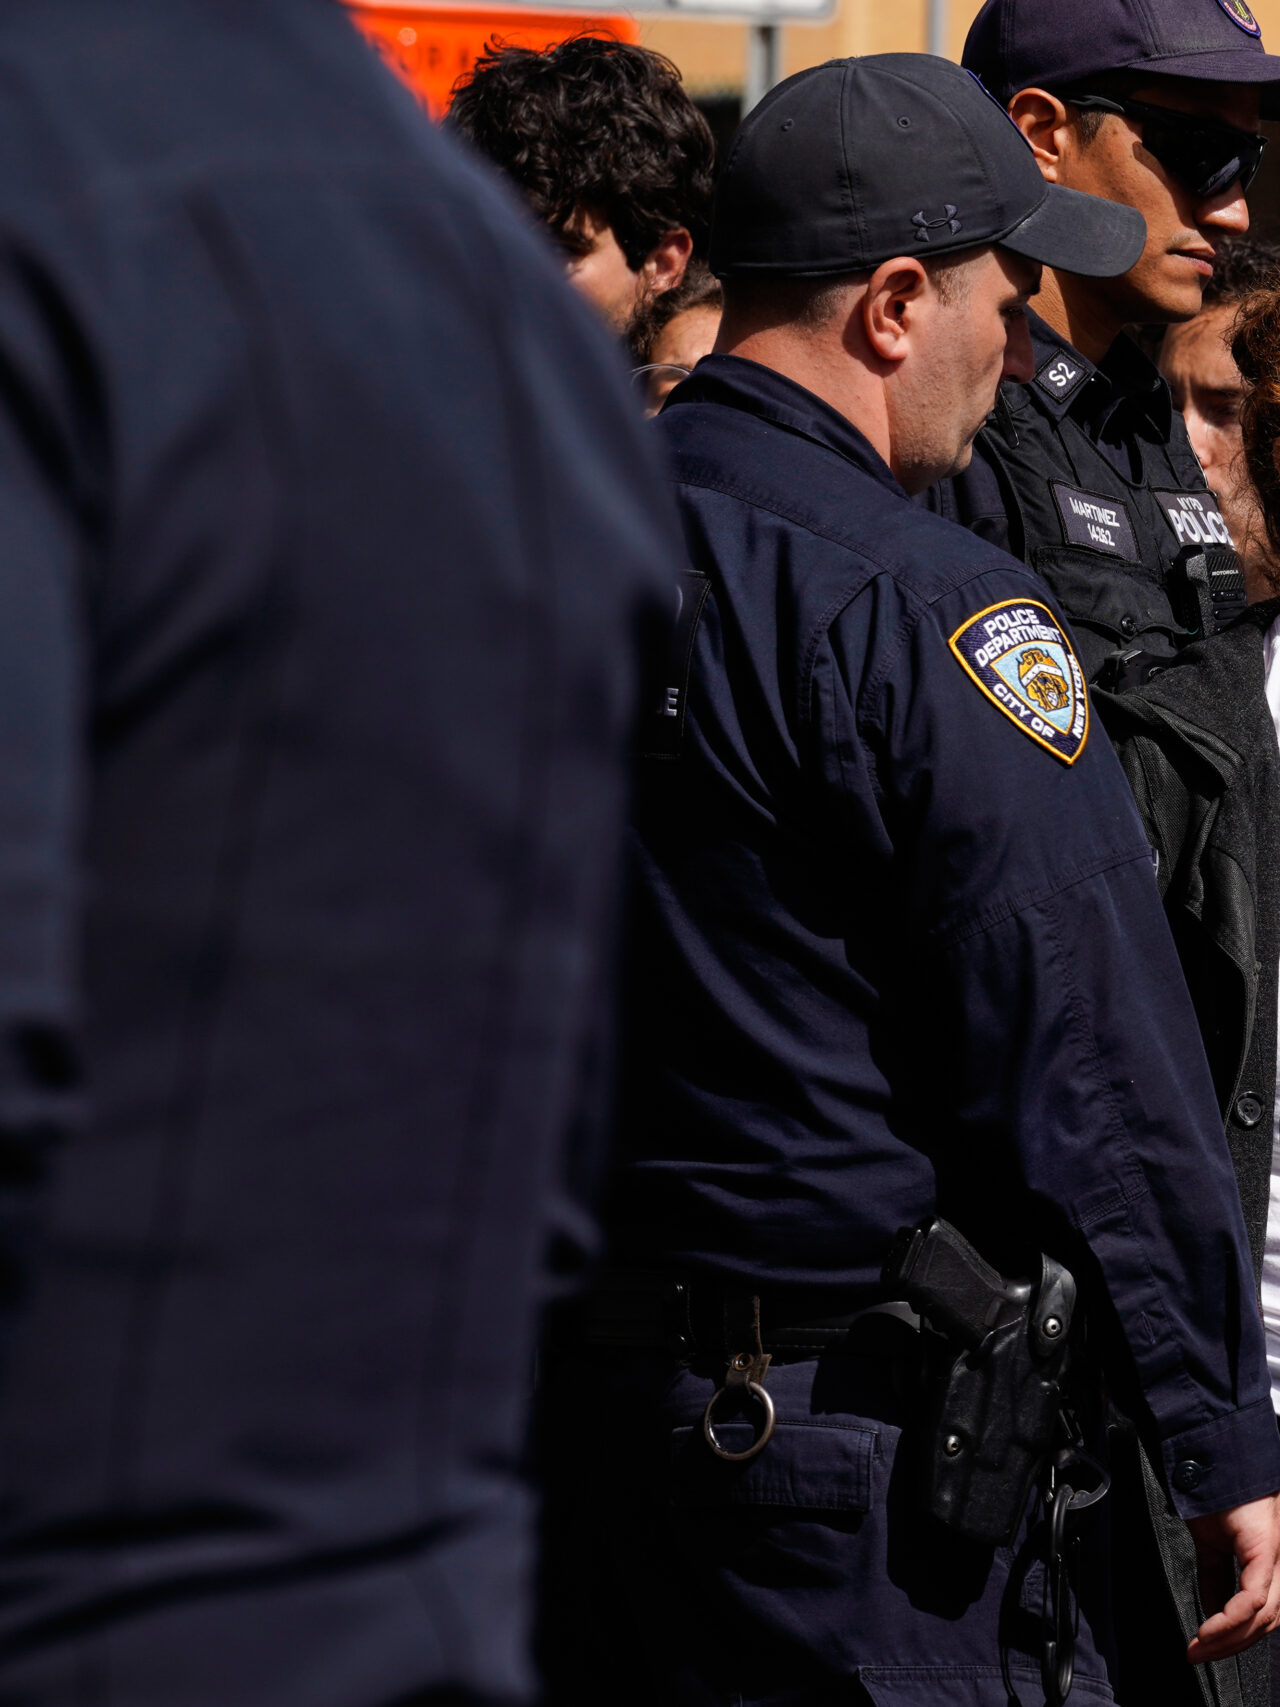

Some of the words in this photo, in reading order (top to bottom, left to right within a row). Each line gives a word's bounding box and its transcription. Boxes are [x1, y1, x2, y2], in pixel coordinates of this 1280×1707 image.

[1048, 361, 1076, 388] S2
[1069, 496, 1121, 528] MARTINEZ
[1211, 569, 1240, 577] MOTOROLA
[983, 608, 1040, 638] POLICE
[974, 625, 1064, 668] DEPARTMENT
[1066, 653, 1085, 700] YORK
[993, 683, 1033, 718] CITY
[1030, 718, 1057, 739] OF
[1071, 700, 1086, 739] NEW
